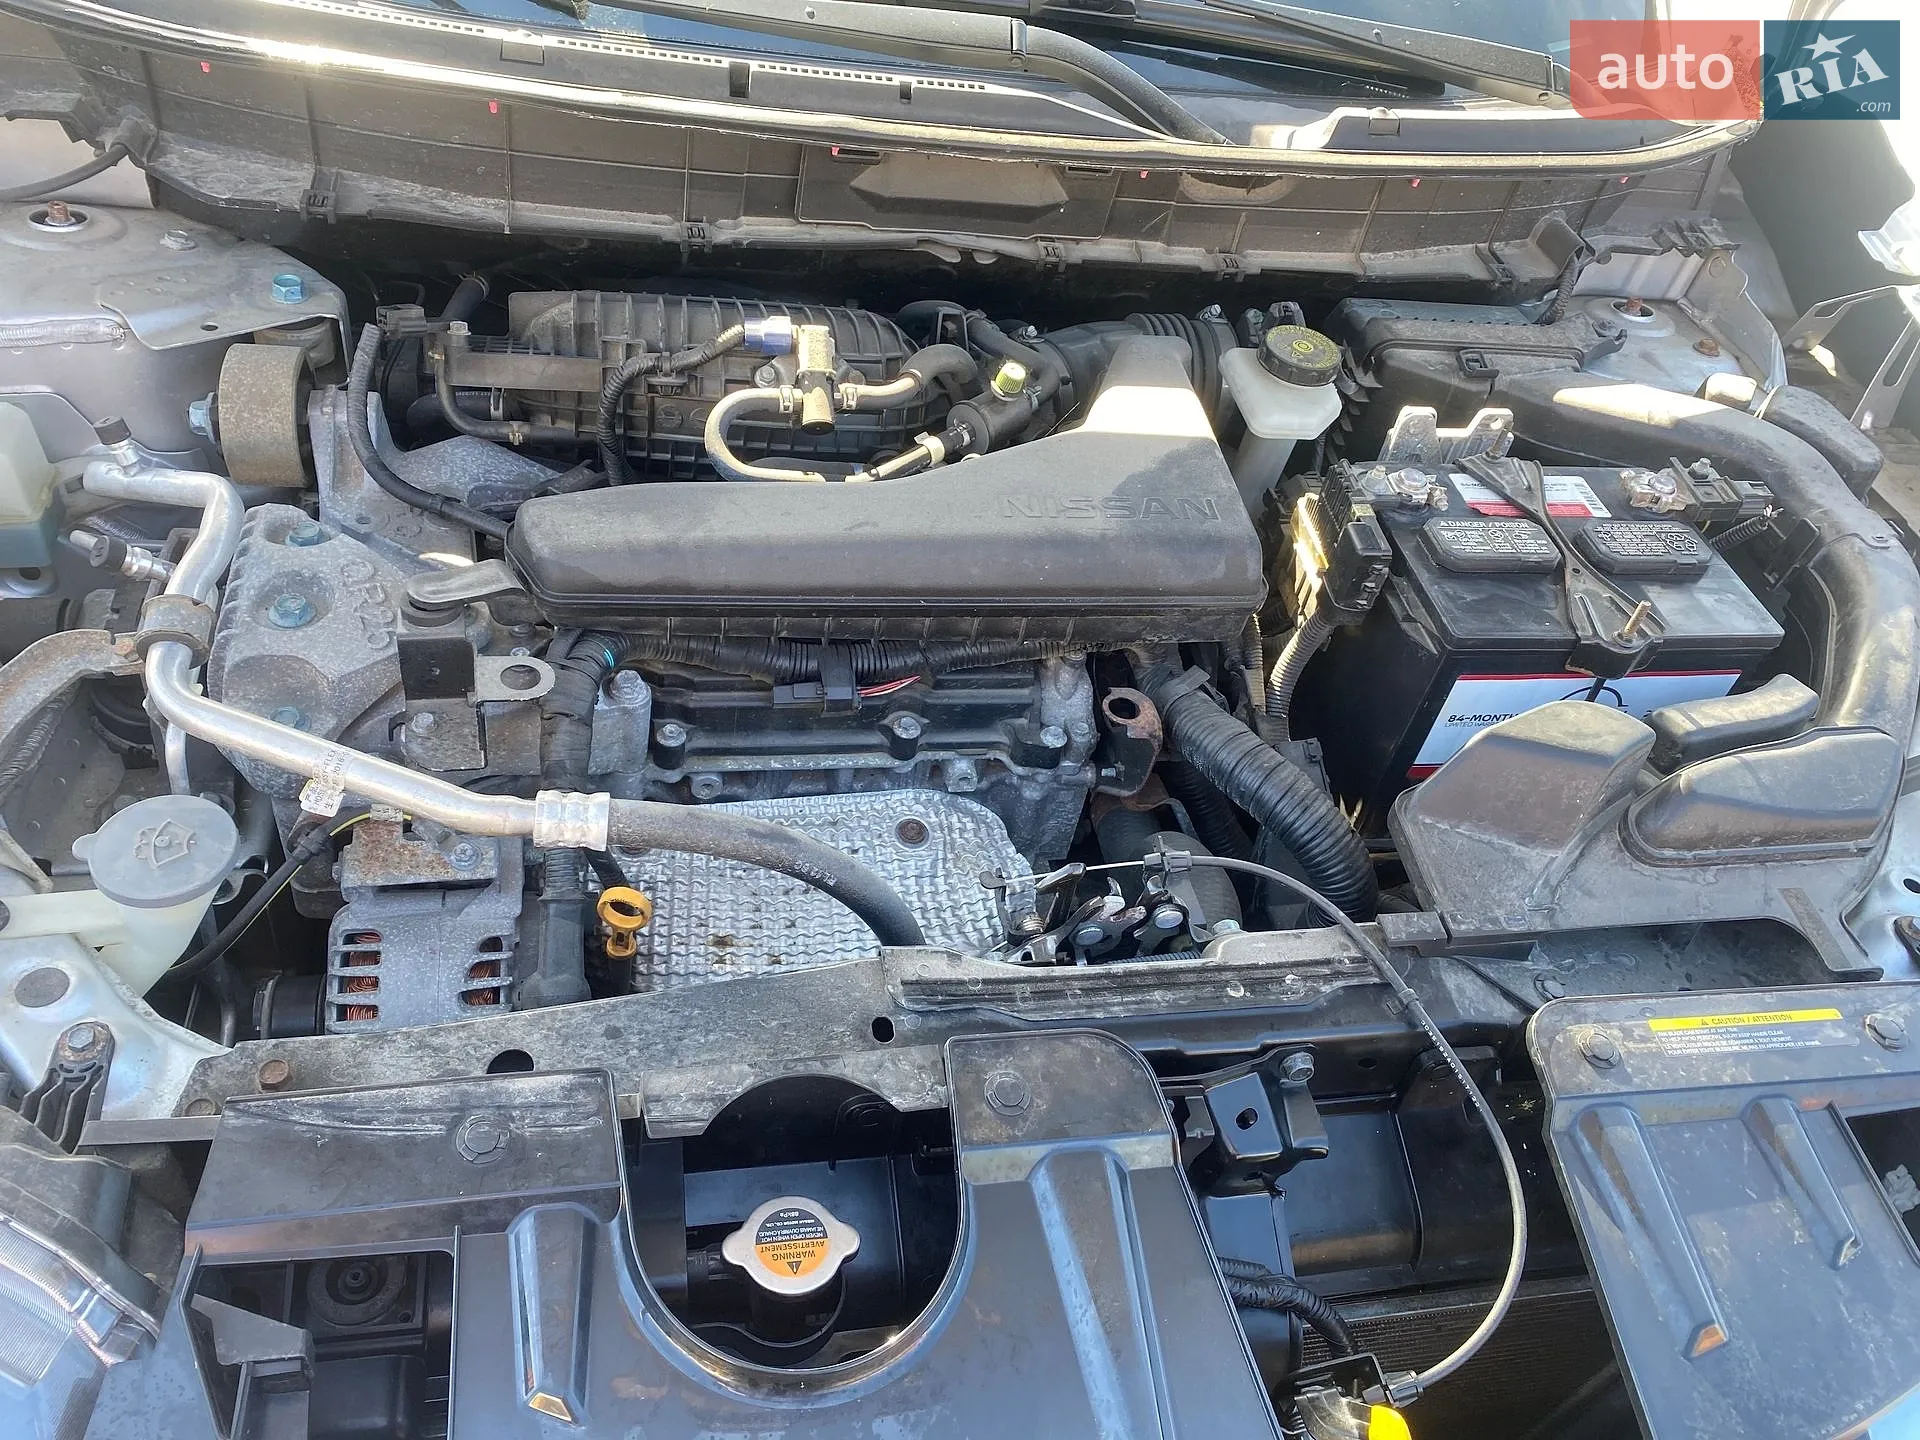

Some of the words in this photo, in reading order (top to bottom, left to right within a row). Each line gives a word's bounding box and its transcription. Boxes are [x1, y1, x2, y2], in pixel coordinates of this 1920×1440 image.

[1003, 496, 1220, 521] NISSAN
[1449, 520, 1487, 528] DANGER
[1711, 1016, 1745, 1025] CAUTION
[1752, 1013, 1793, 1023] ATTENTION
[760, 1240, 825, 1253] AVERTISSEMENT
[771, 1250, 816, 1261] WARNING
